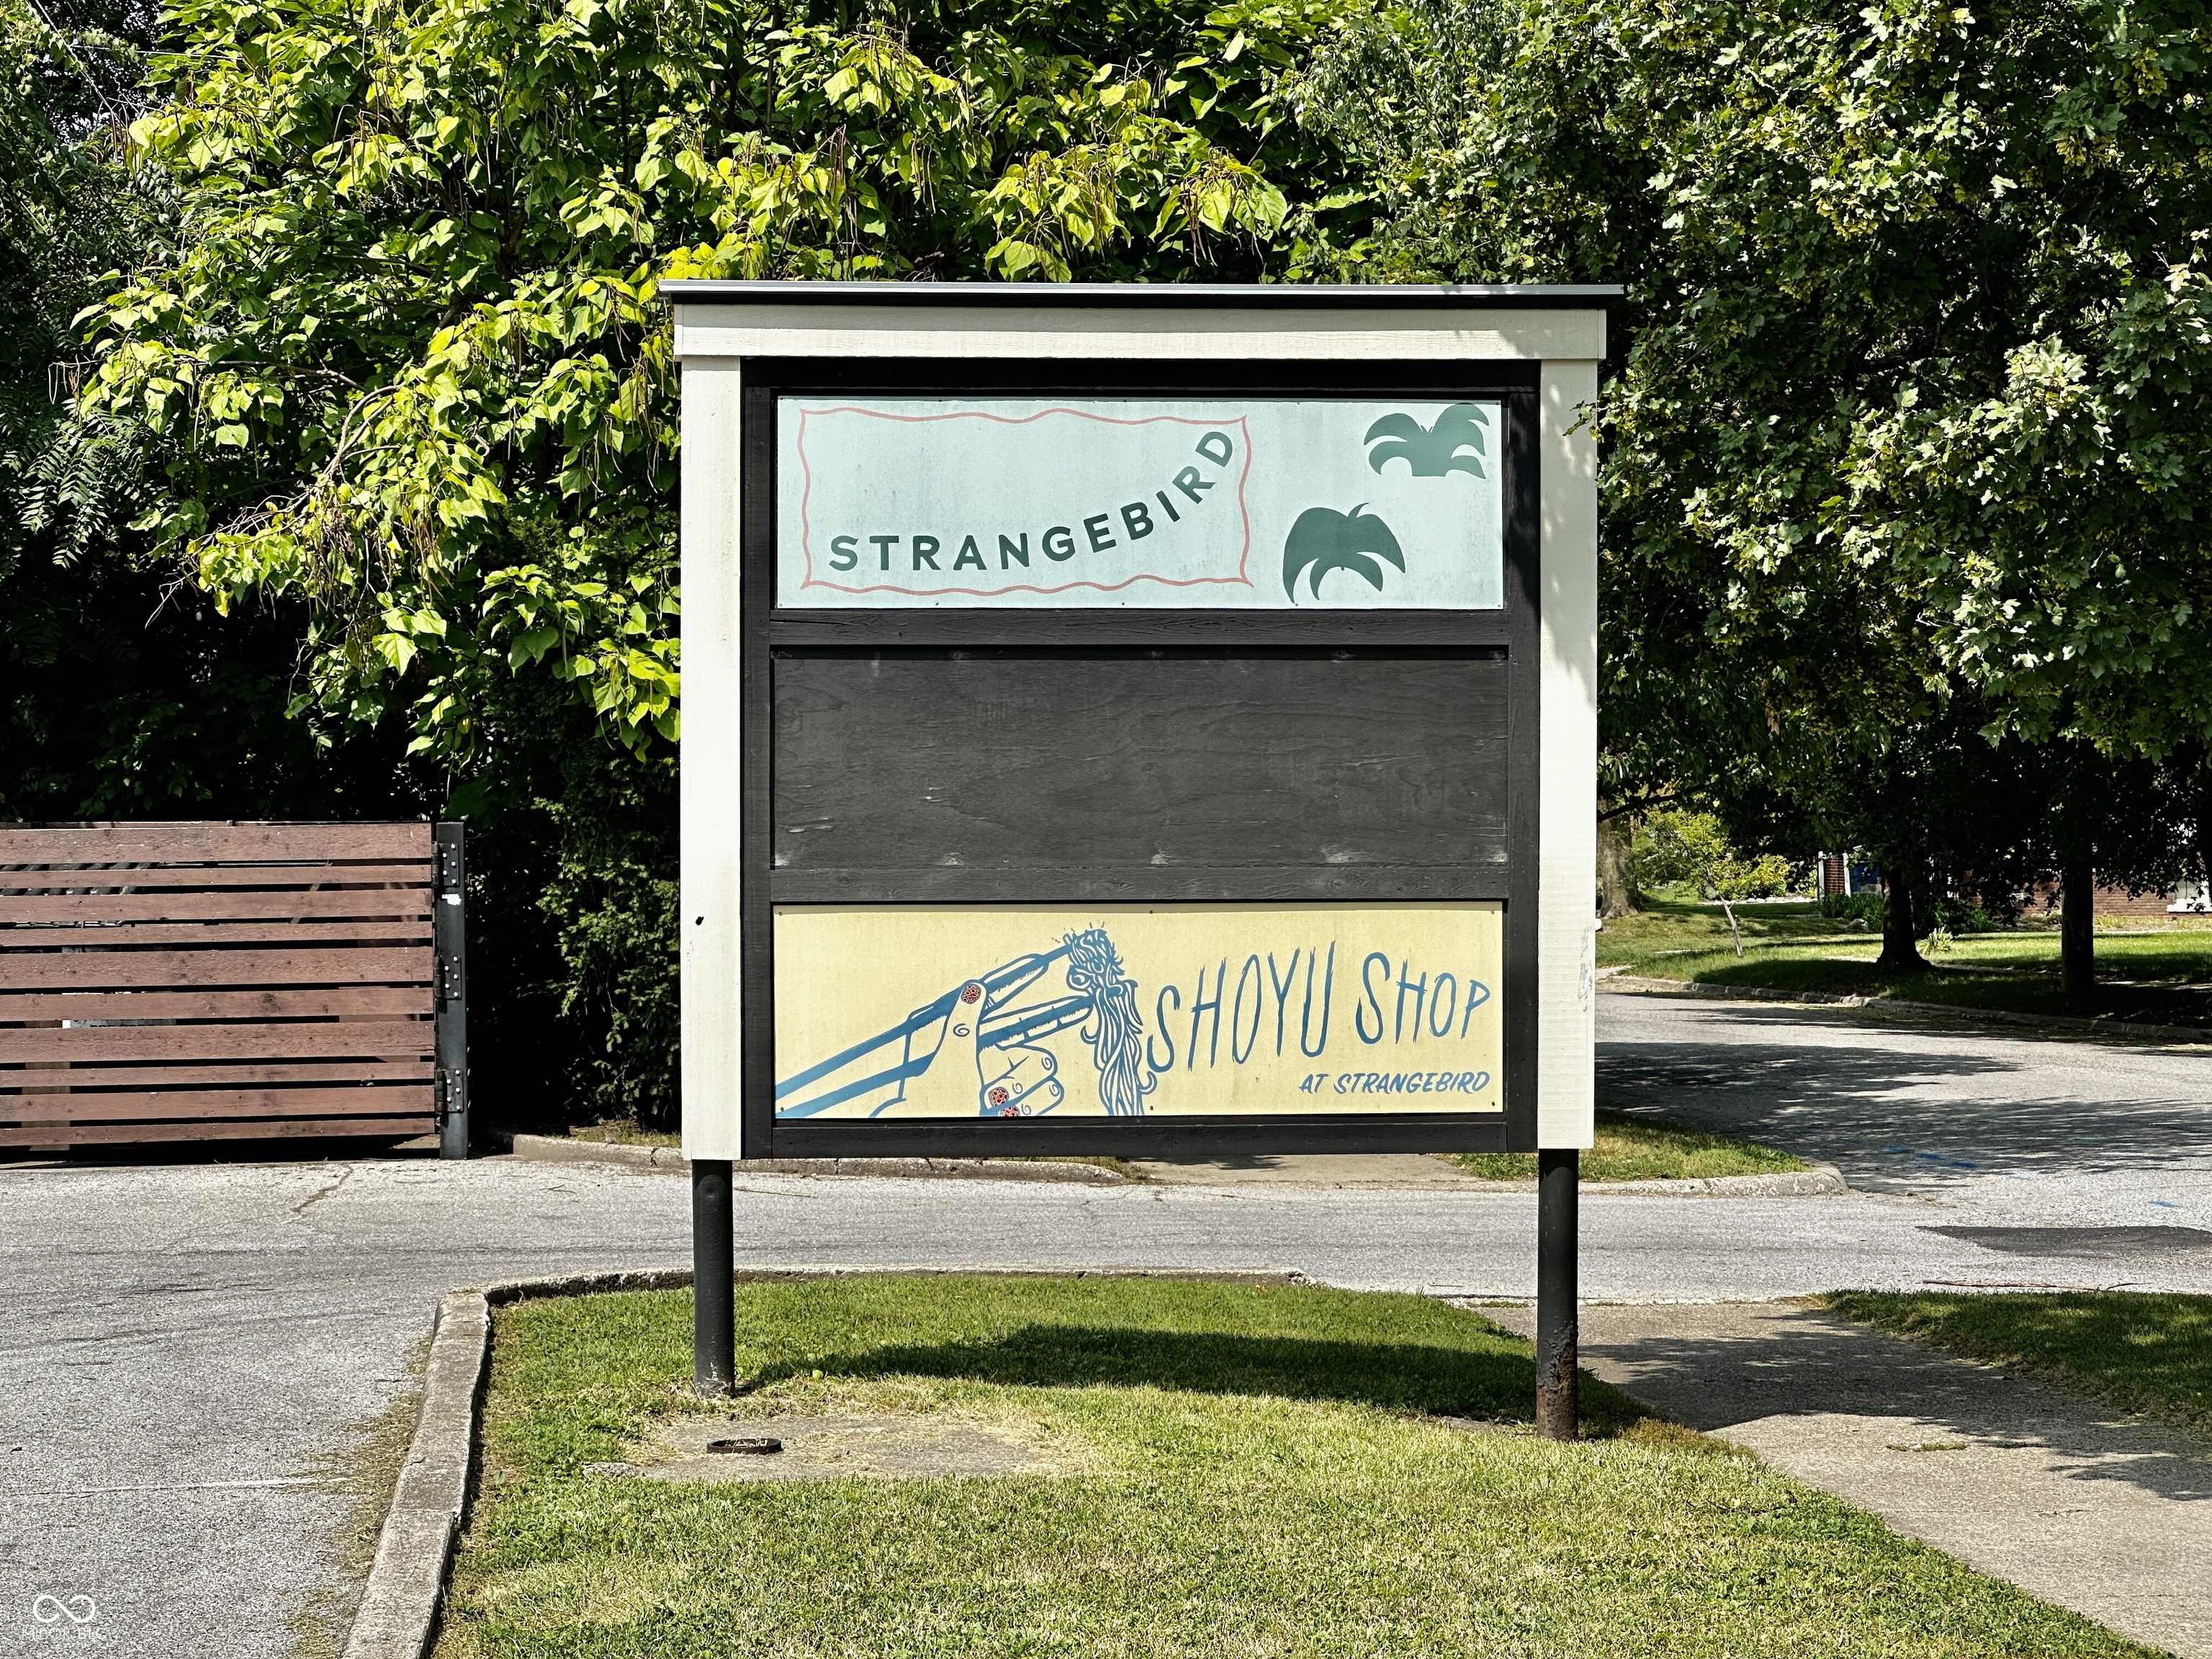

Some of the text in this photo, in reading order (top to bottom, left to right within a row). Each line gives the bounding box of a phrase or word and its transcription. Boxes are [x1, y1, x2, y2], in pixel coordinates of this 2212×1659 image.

[828, 431, 1233, 571] STRANGEBIRD
[1147, 940, 1491, 1073] SHOYU SHOP
[1299, 1071, 1491, 1094] AT STRANGEBIRD
